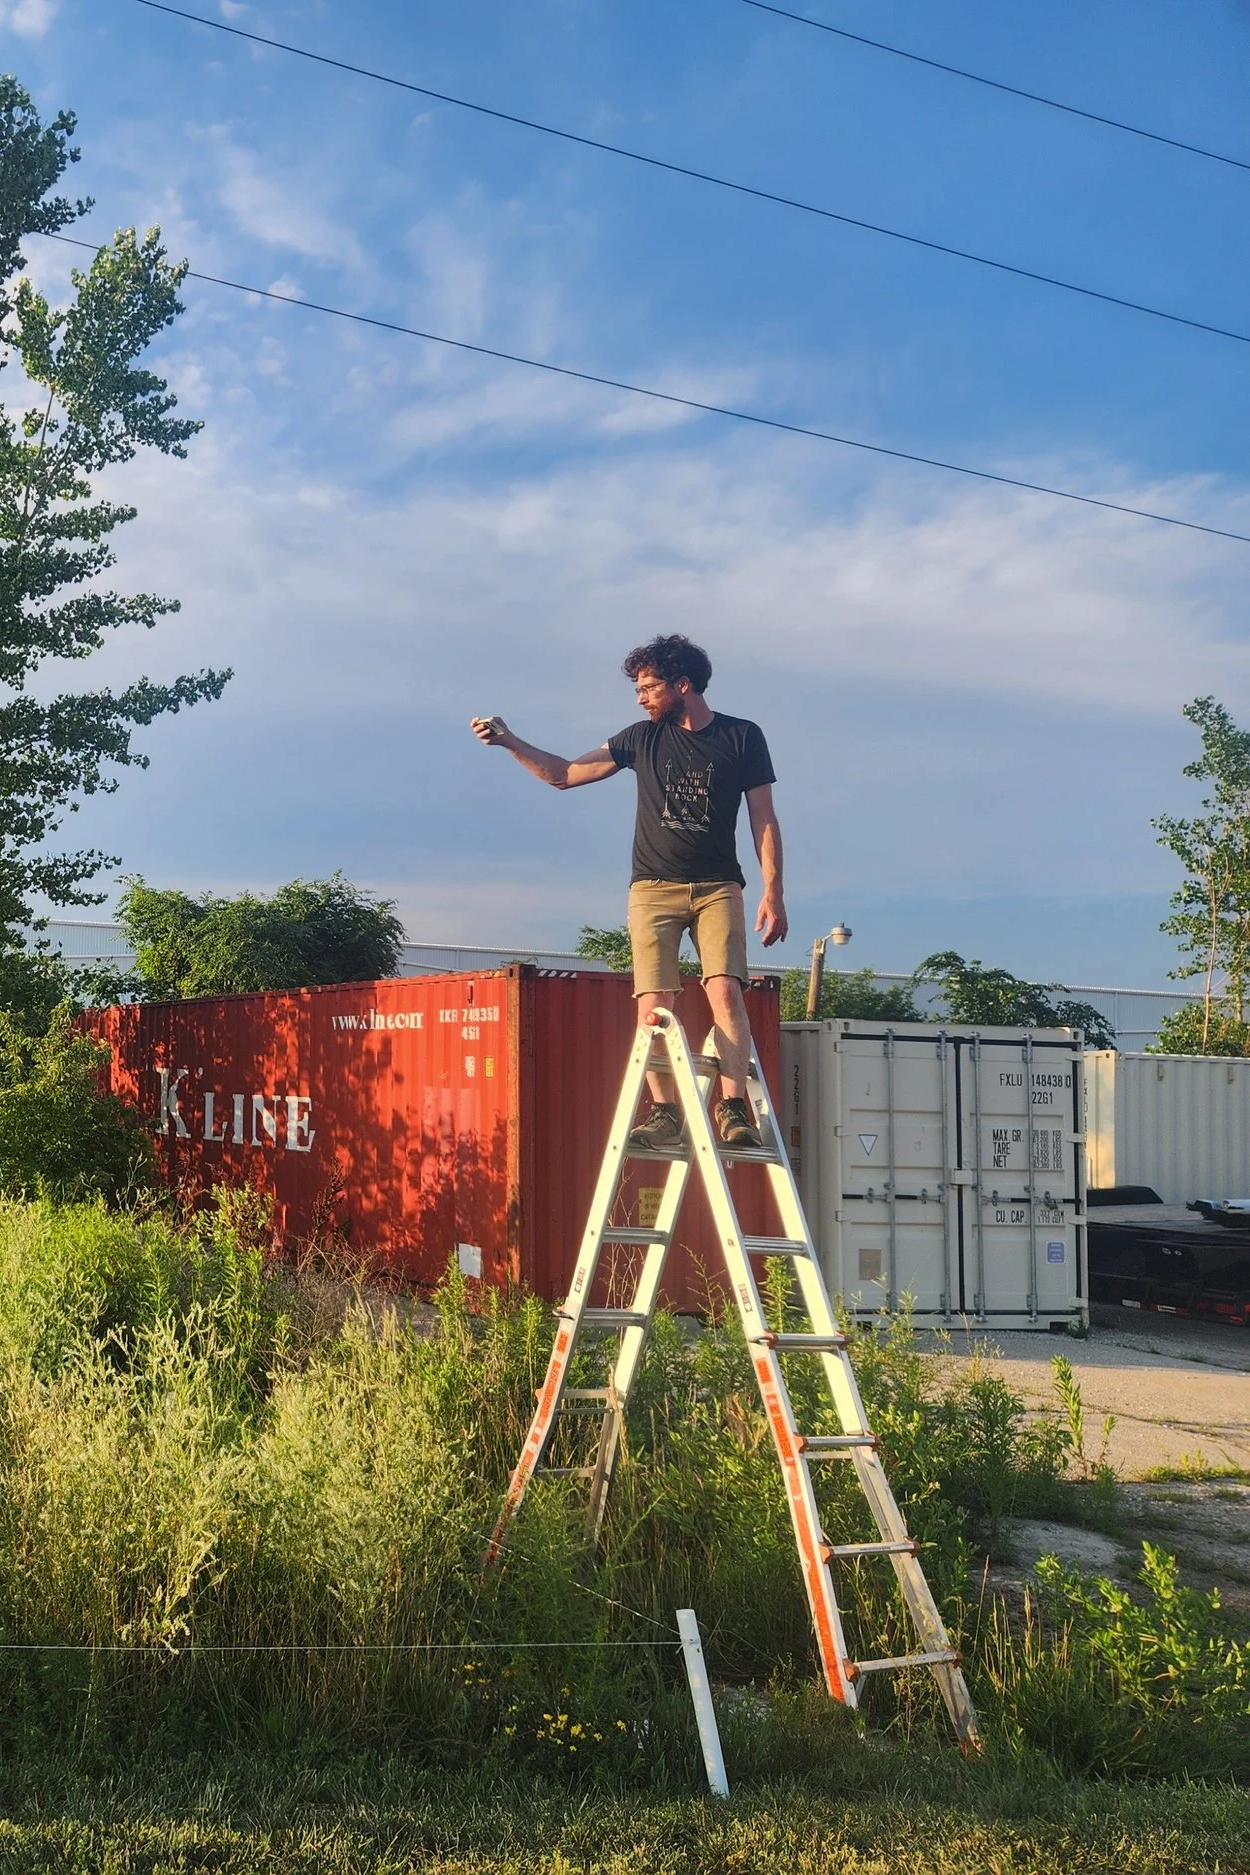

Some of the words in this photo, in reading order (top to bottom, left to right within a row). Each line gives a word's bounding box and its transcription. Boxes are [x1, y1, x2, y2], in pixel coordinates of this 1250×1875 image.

[665, 784, 709, 796] STANDING
[674, 793, 698, 802] ROCK
[999, 1073, 1023, 1087] FXLU
[1031, 1074, 1063, 1088] 148438
[1031, 1091, 1053, 1105] 22G1
[203, 1091, 316, 1153] LINE
[1011, 1129, 1024, 1142] GR.
[992, 1141, 1011, 1155] TARE
[992, 1155, 1008, 1168] NET
[995, 1209, 1008, 1223] CU.
[1010, 1209, 1027, 1224] CAP.
